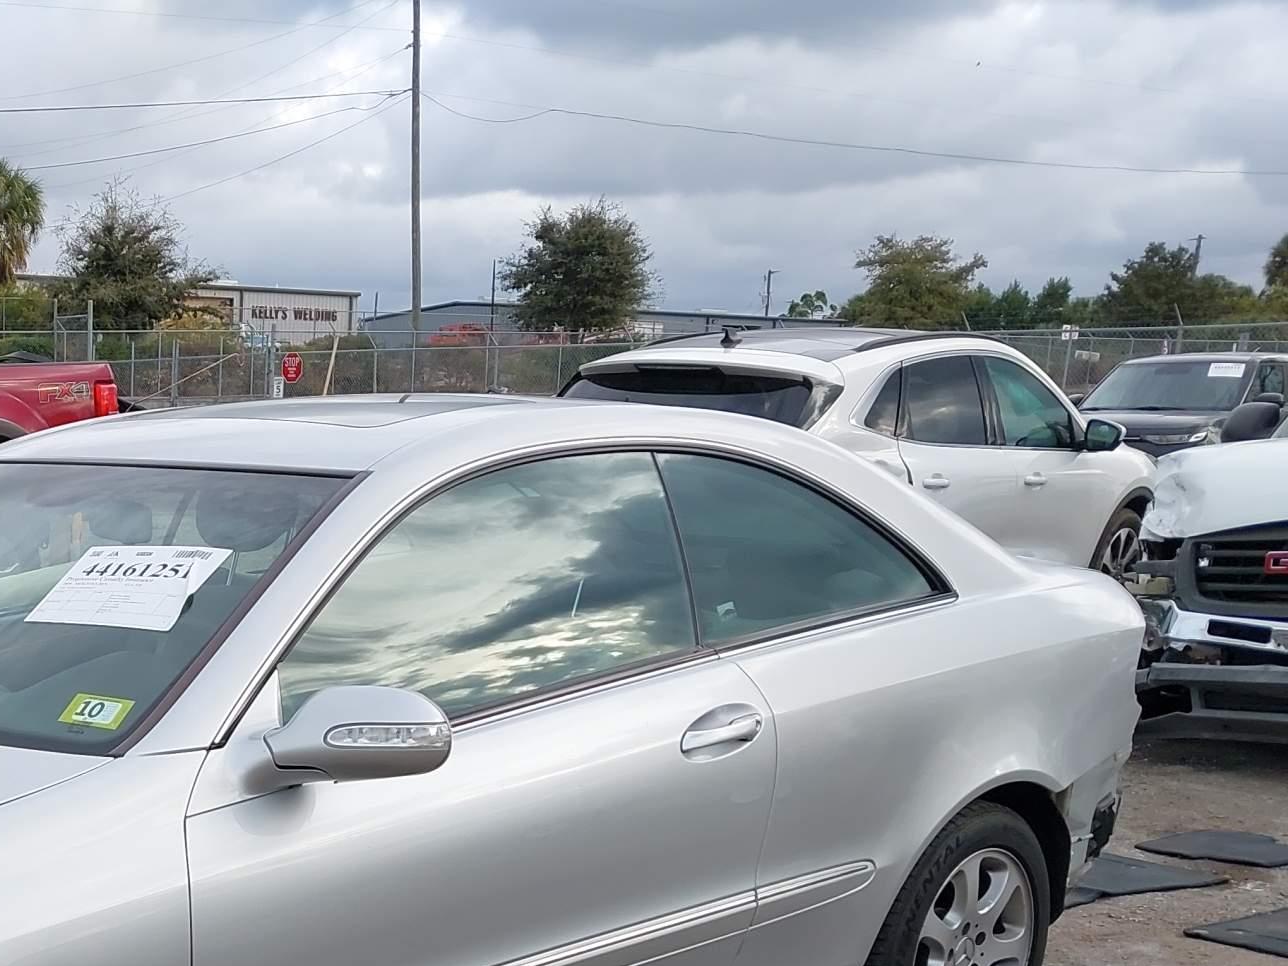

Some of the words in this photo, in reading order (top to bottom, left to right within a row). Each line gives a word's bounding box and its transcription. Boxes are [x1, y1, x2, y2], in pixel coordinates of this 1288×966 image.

[251, 305, 288, 320] KELLY'S
[293, 307, 337, 322] WELDING
[284, 357, 300, 367] STOP
[38, 381, 90, 403] FX4
[82, 562, 194, 578] 44161251
[74, 701, 105, 718] 10
